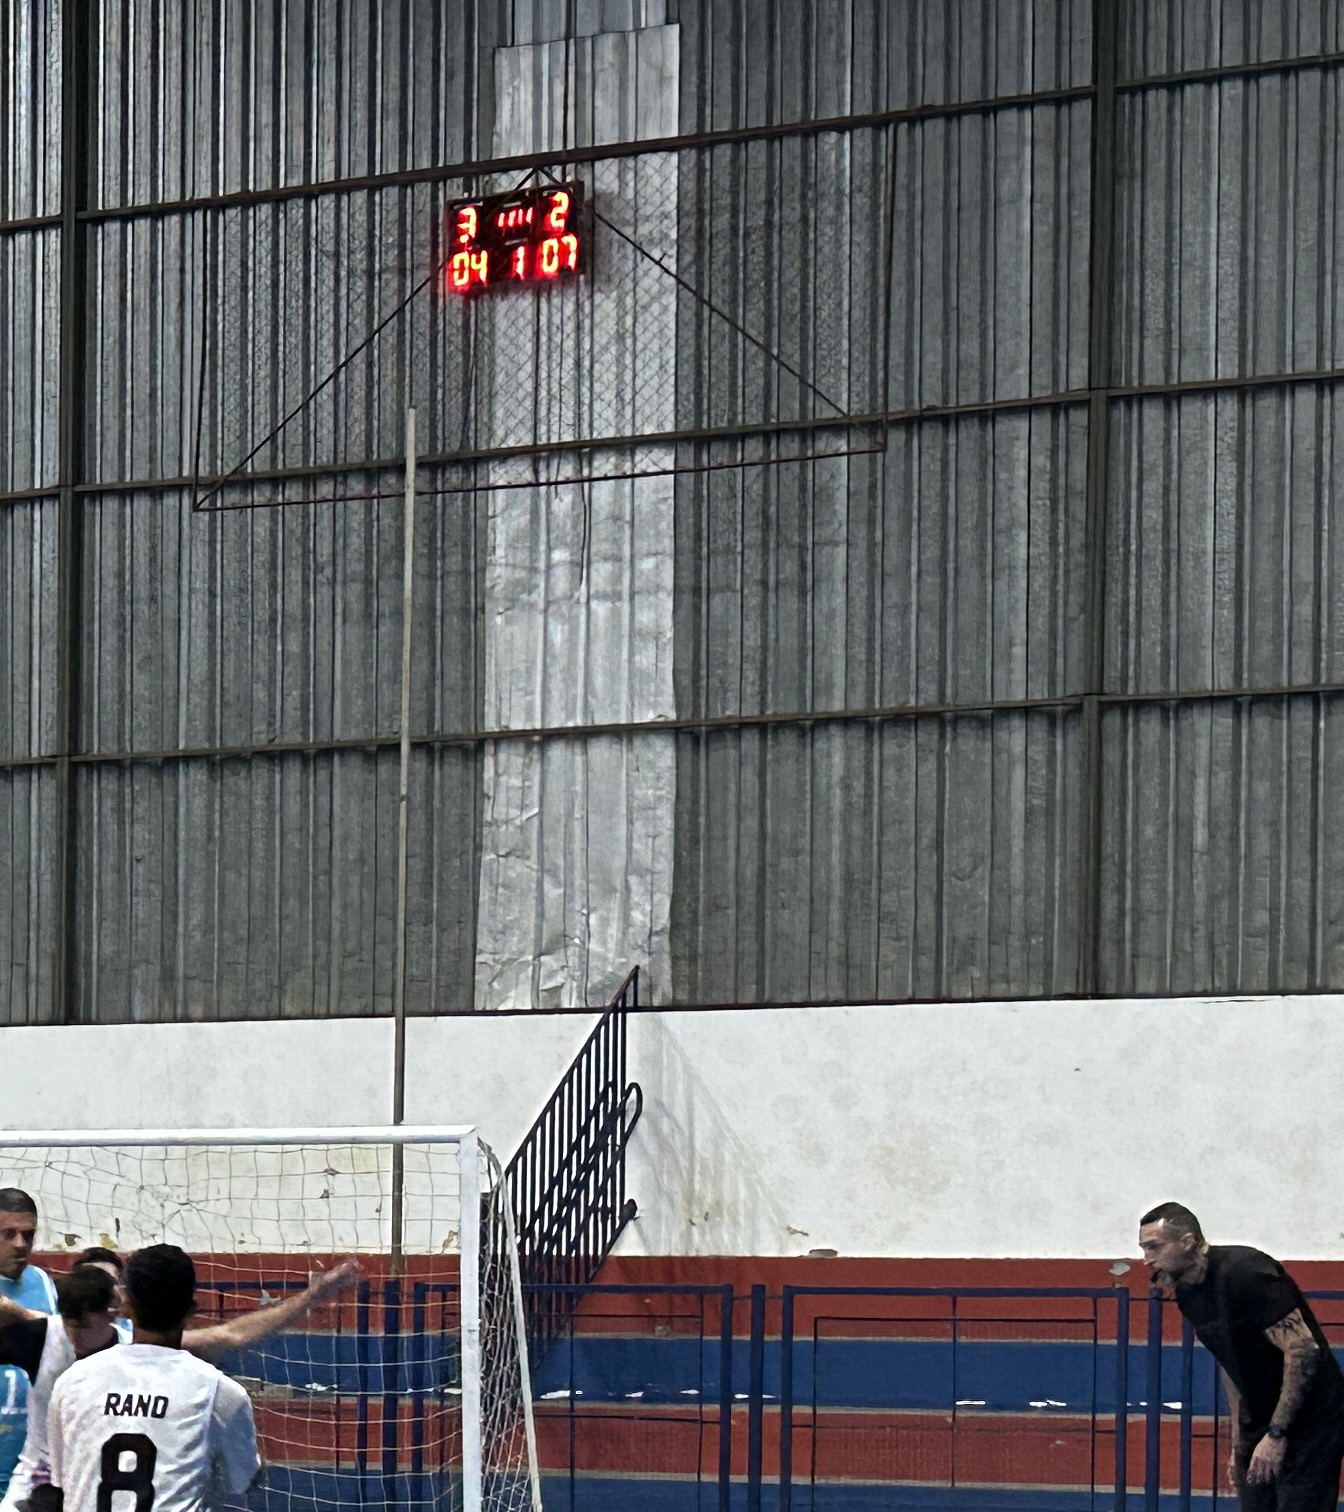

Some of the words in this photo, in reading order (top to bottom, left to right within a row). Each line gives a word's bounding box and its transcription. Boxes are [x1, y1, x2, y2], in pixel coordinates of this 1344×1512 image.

[548, 191, 570, 231] 2
[451, 249, 489, 288] 04
[541, 234, 579, 275] 07
